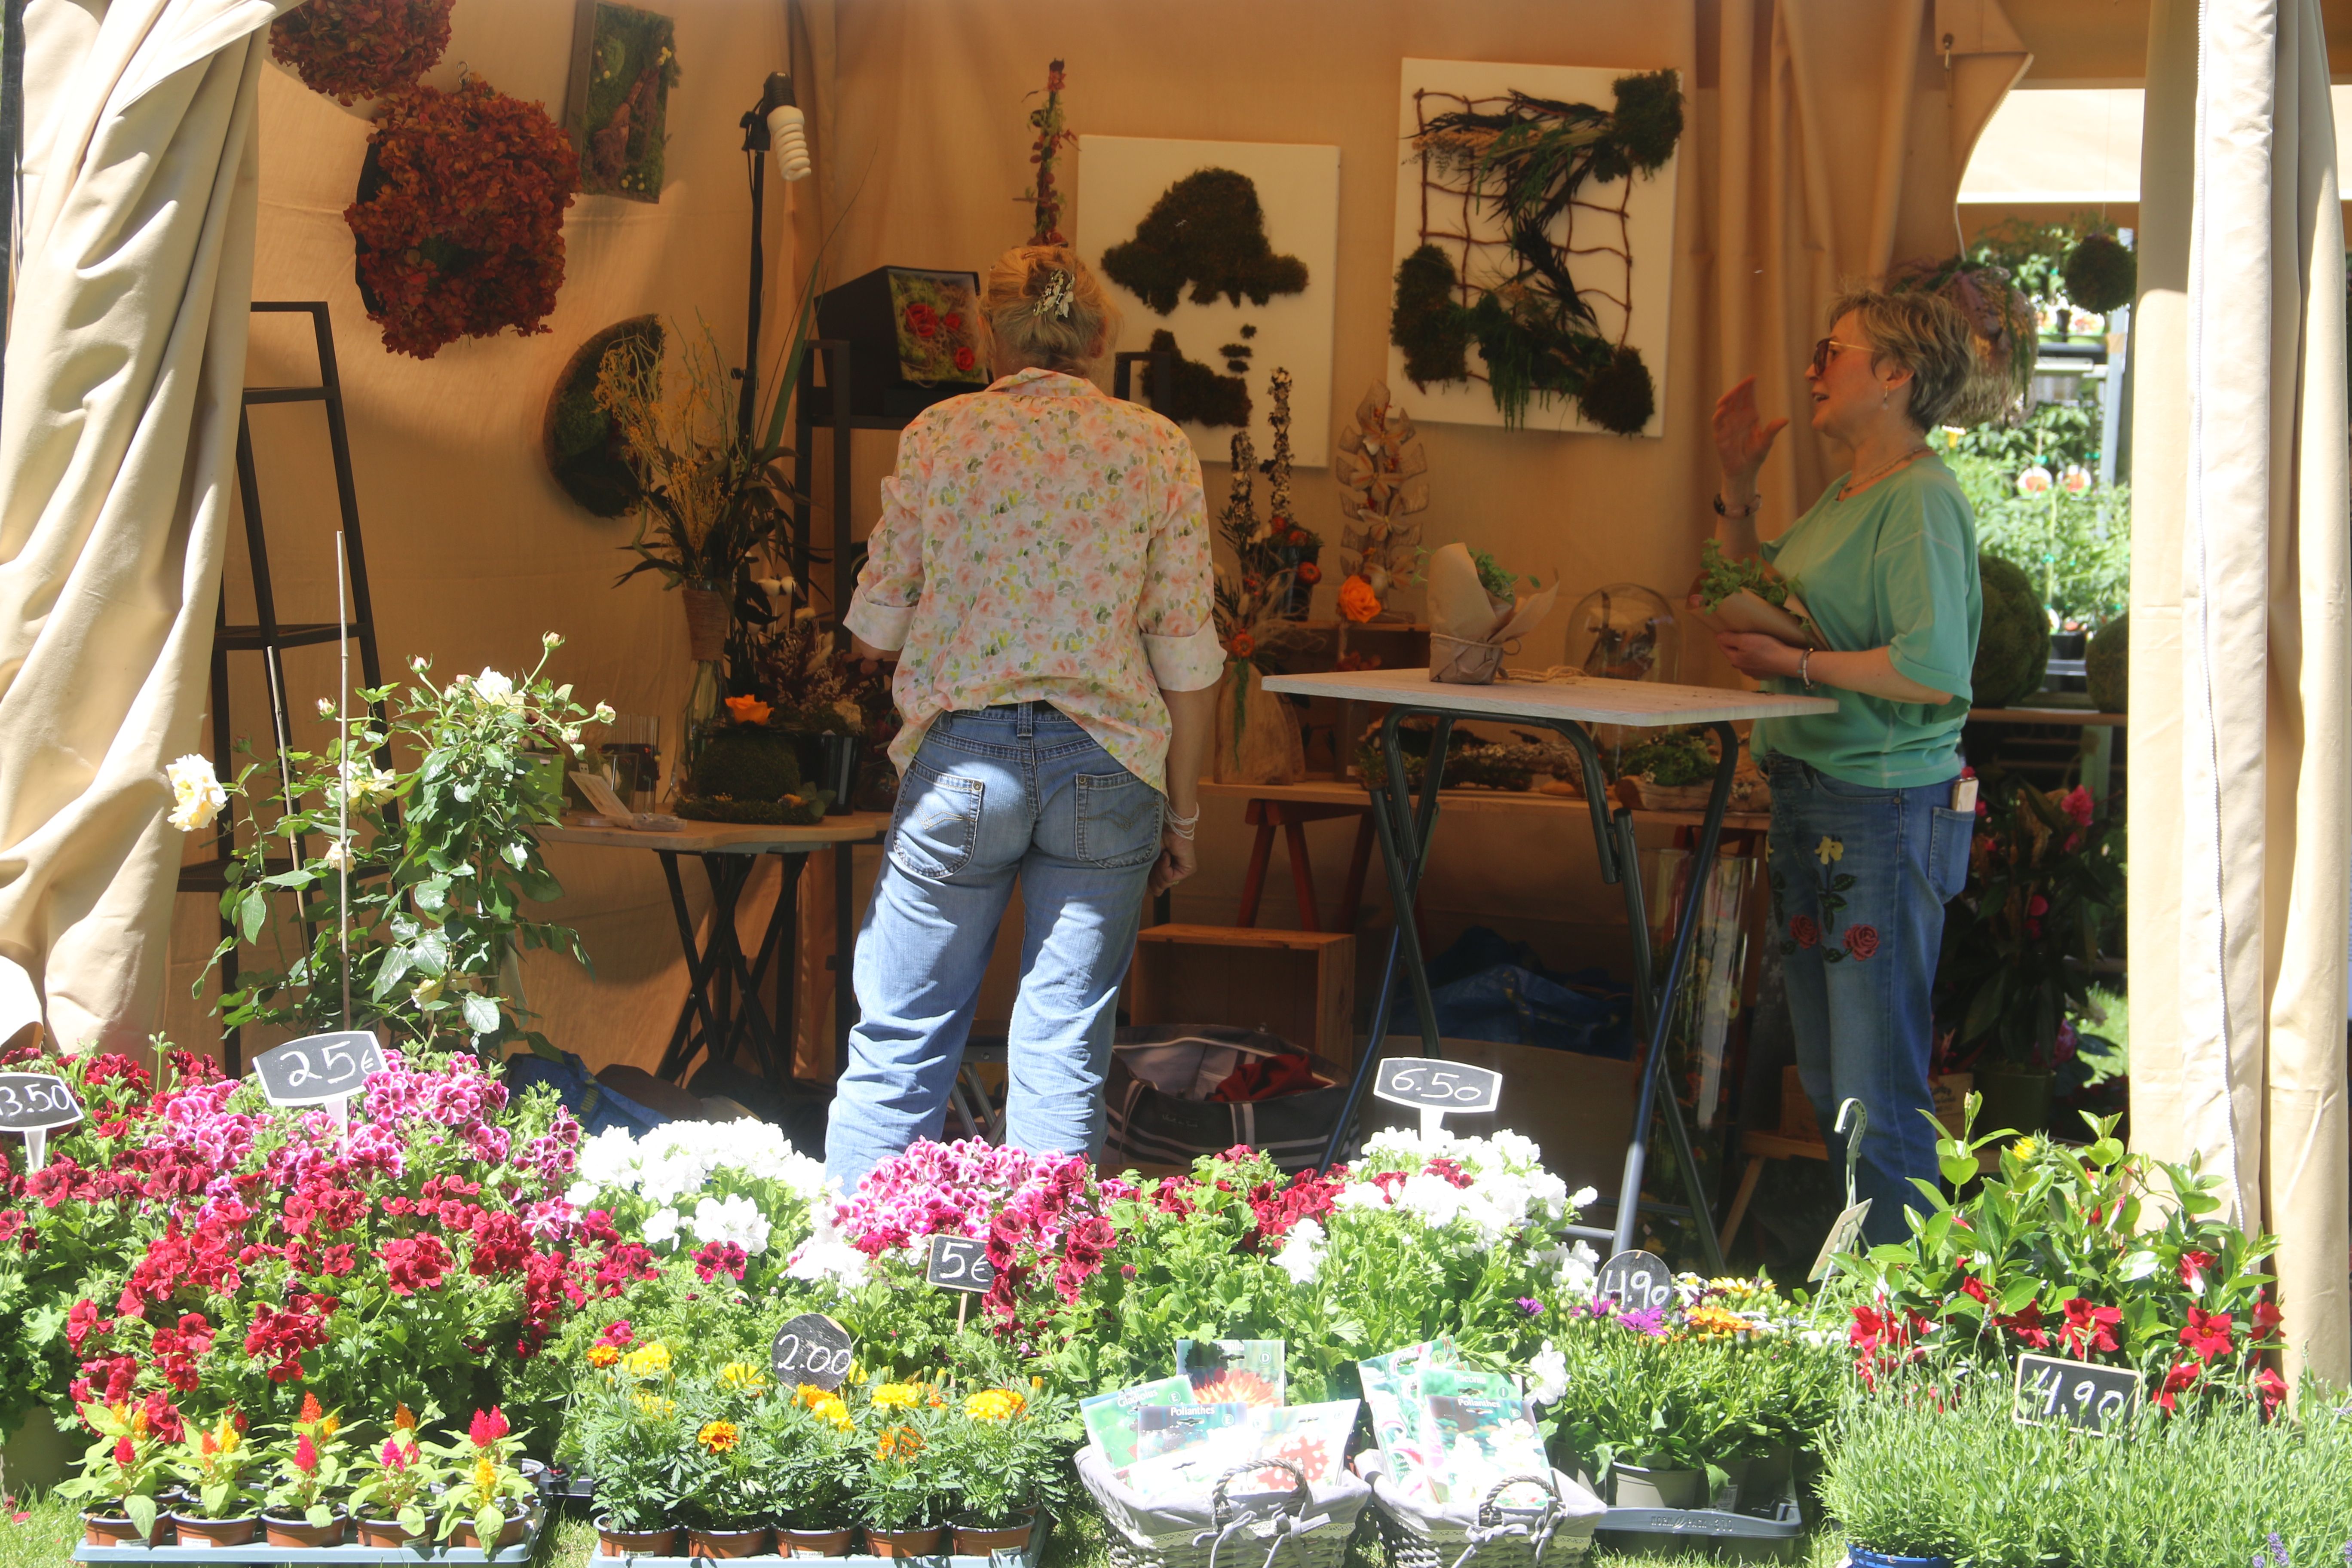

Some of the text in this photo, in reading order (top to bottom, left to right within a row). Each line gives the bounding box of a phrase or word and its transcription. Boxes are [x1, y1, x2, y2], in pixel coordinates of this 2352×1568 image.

[280, 1041, 374, 1087] 25€
[0, 1083, 70, 1117] 3.50
[1392, 1068, 1482, 1101] 6.50
[940, 1242, 989, 1283] 5€
[1605, 1270, 1669, 1309] 4.90
[777, 1334, 851, 1375] 2.00
[1117, 1388, 1158, 1407] Gladiolus
[2030, 1366, 2124, 1420] 4.90
